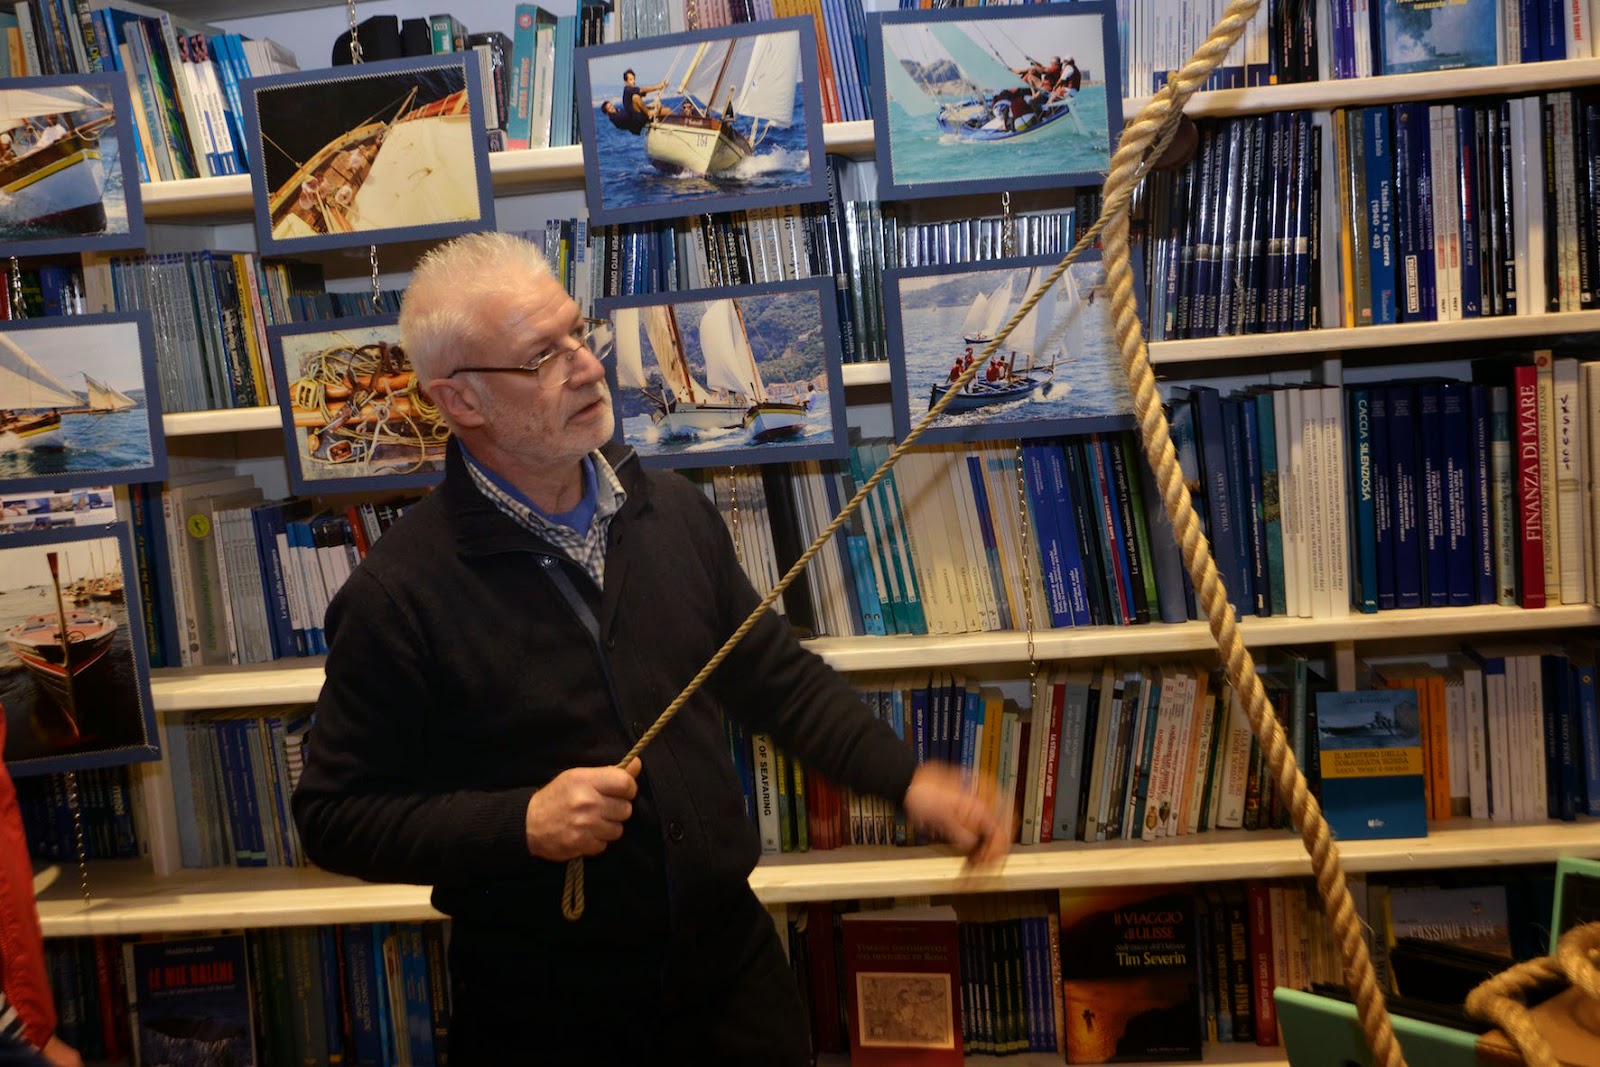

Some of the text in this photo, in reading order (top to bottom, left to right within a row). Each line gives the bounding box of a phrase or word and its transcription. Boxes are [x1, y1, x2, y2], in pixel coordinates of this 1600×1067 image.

[518, 57, 530, 119] SCUBA DIVING
[1370, 199, 1381, 226] (1940
[1380, 180, 1391, 267] L'Italia e la Guerra
[611, 223, 619, 251] EEPER
[1371, 234, 1381, 249] 43)
[610, 270, 618, 296] DIVING
[1358, 399, 1371, 501] CACCIA SILENZIOSA
[1520, 384, 1541, 541] FINANZA DI MARE
[1538, 383, 1554, 575] LE UNIFORMI STORICHE DELLE MARINE ITALIANE
[1124, 503, 1134, 538] Serenissima.
[1128, 538, 1136, 553] della
[1130, 553, 1138, 566] navi
[1131, 566, 1139, 575] Le
[275, 580, 284, 596] della
[277, 595, 287, 610] leggi
[280, 610, 288, 620] Le
[1561, 714, 1571, 765] TESEO TESEI
[1148, 728, 1164, 801] Atlante archeologico
[1161, 724, 1176, 796] Atlante archeologico
[1381, 750, 1408, 758] DELLA
[759, 745, 771, 816] OF SEAFARING
[1123, 911, 1184, 924] VIAGGIO
[1465, 919, 1495, 937] 1944
[1136, 926, 1175, 940] ULISSE
[1115, 951, 1187, 967] Tim Severin
